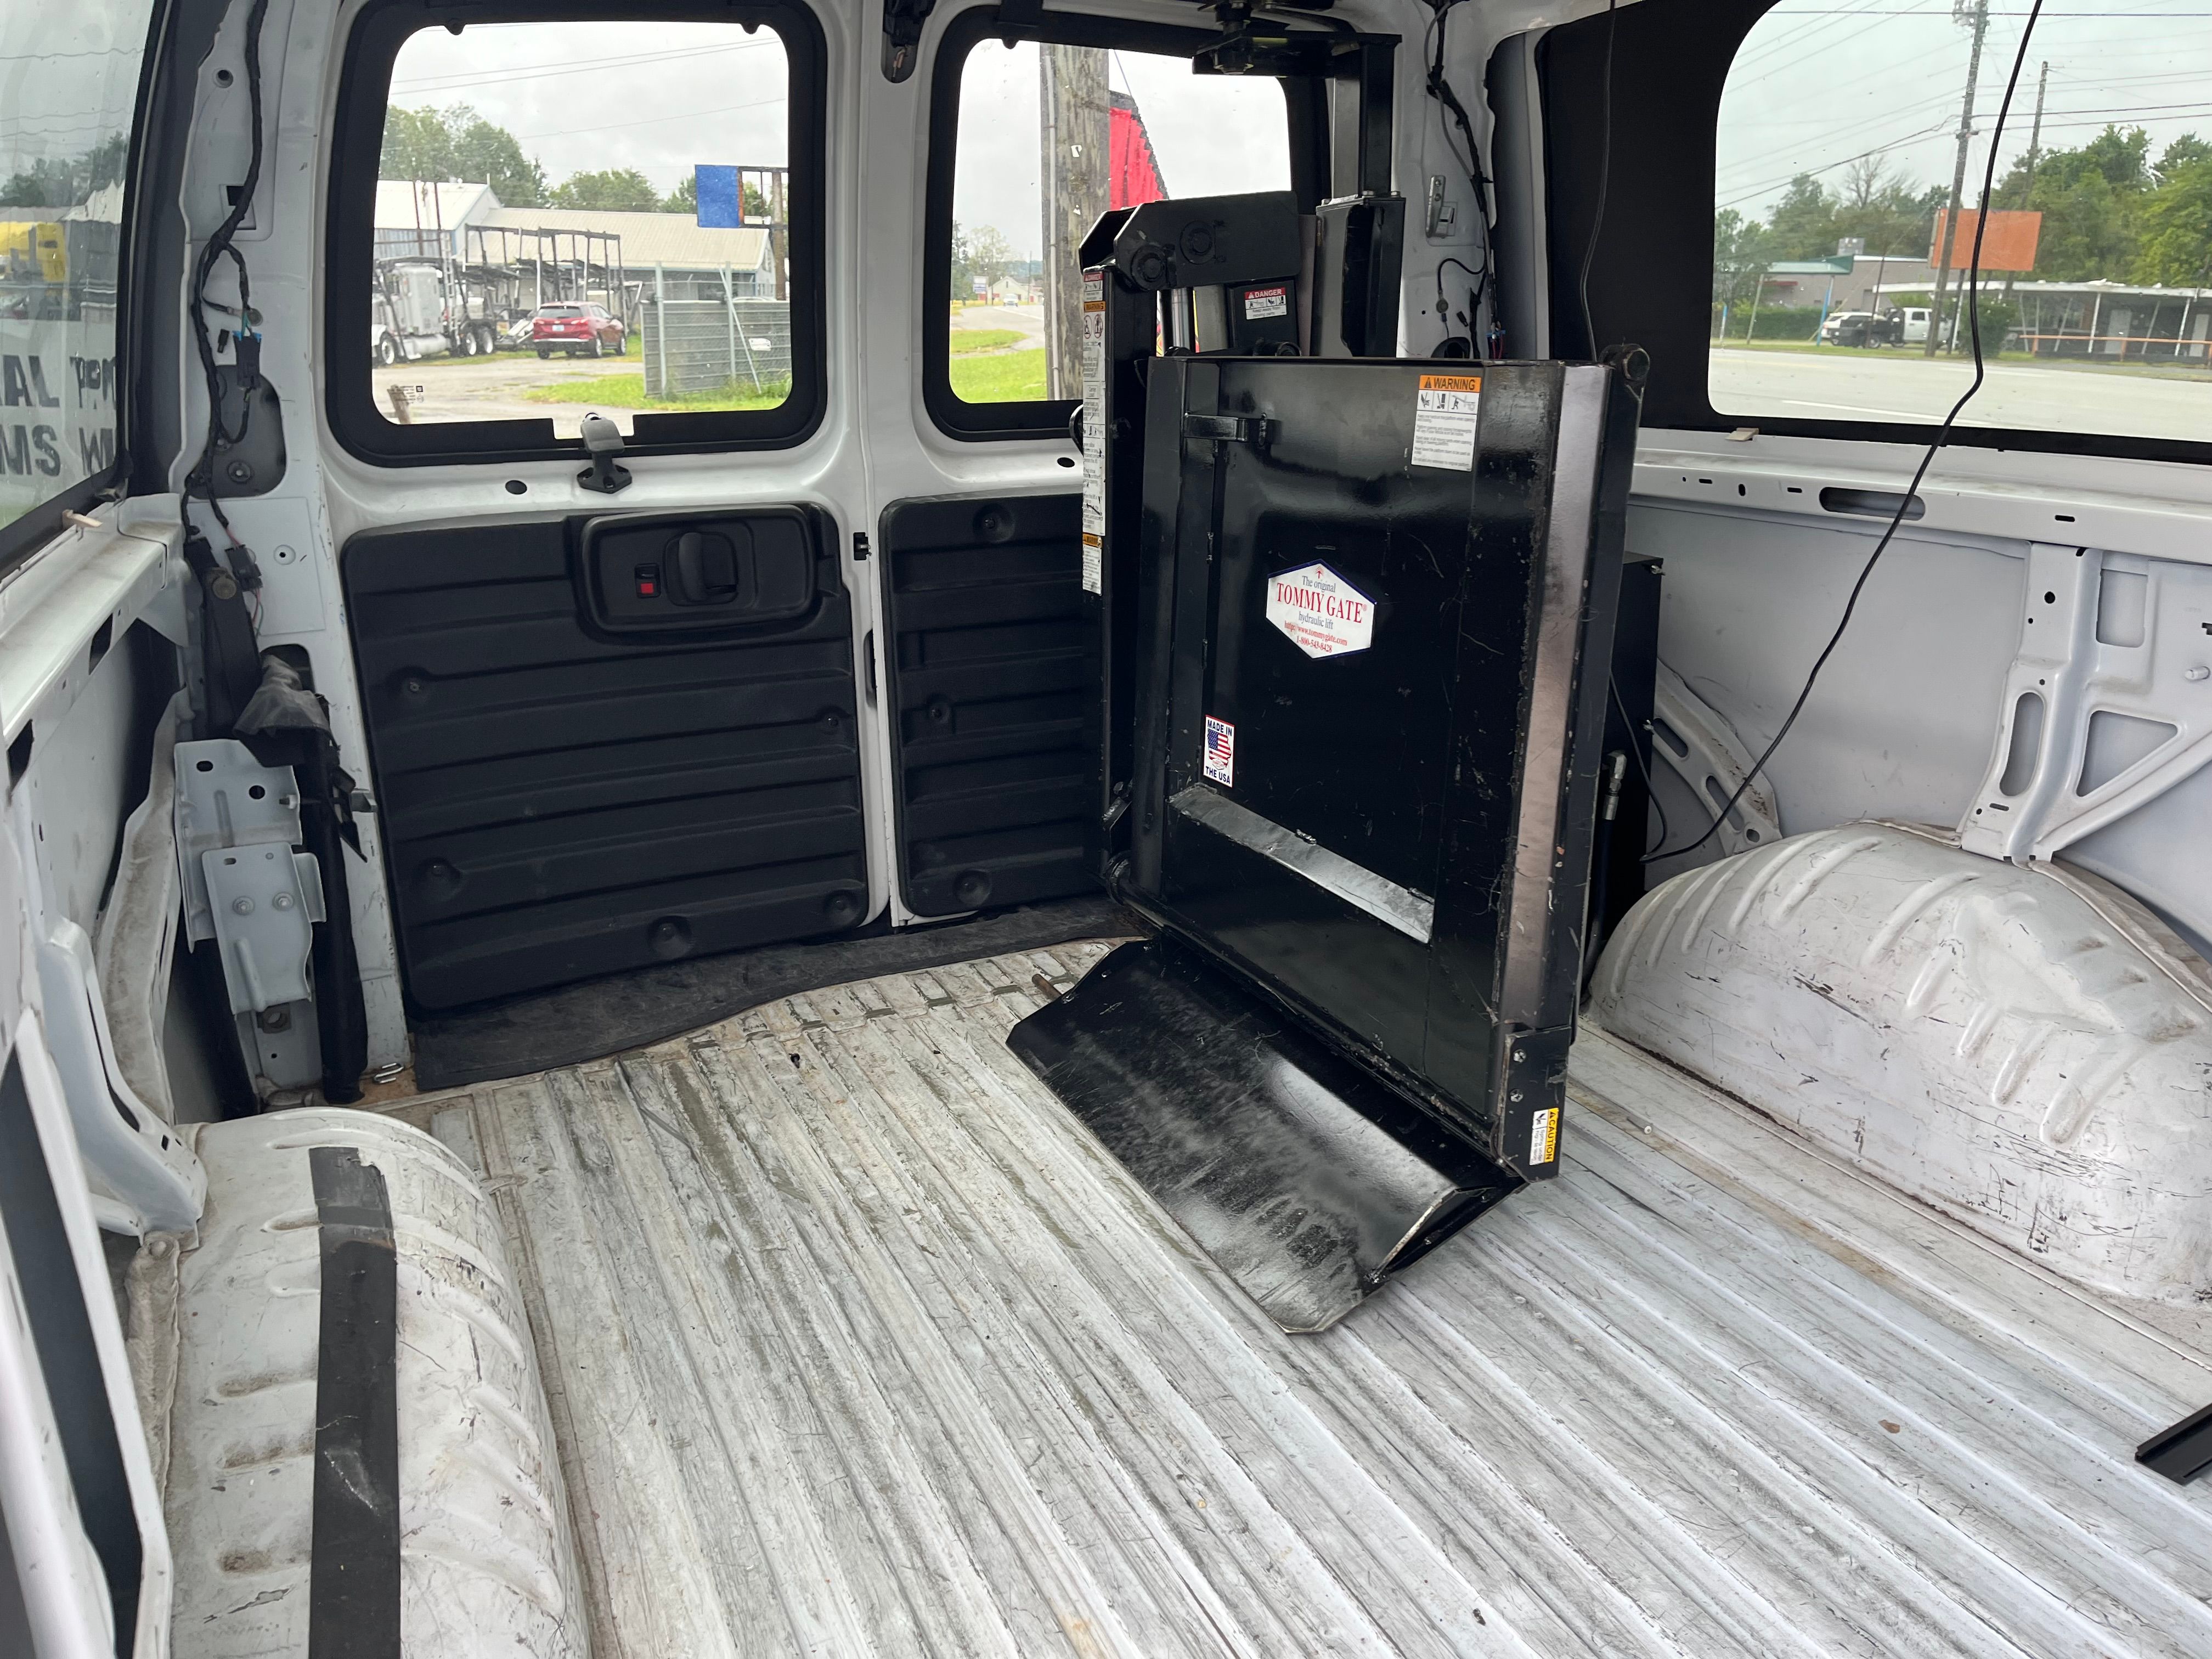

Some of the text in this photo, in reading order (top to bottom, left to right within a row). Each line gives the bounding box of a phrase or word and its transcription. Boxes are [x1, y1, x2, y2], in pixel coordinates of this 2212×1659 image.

[1254, 289, 1282, 298] DANGER
[1434, 377, 1475, 390] WARNING
[1302, 575, 1336, 593] The original
[1277, 583, 1324, 613] TOMMY
[1299, 611, 1334, 629] hydraulic lift
[1207, 719, 1232, 737] MADE IN
[1205, 766, 1231, 785] THE USA
[1545, 1119, 1556, 1160] CAUTION
